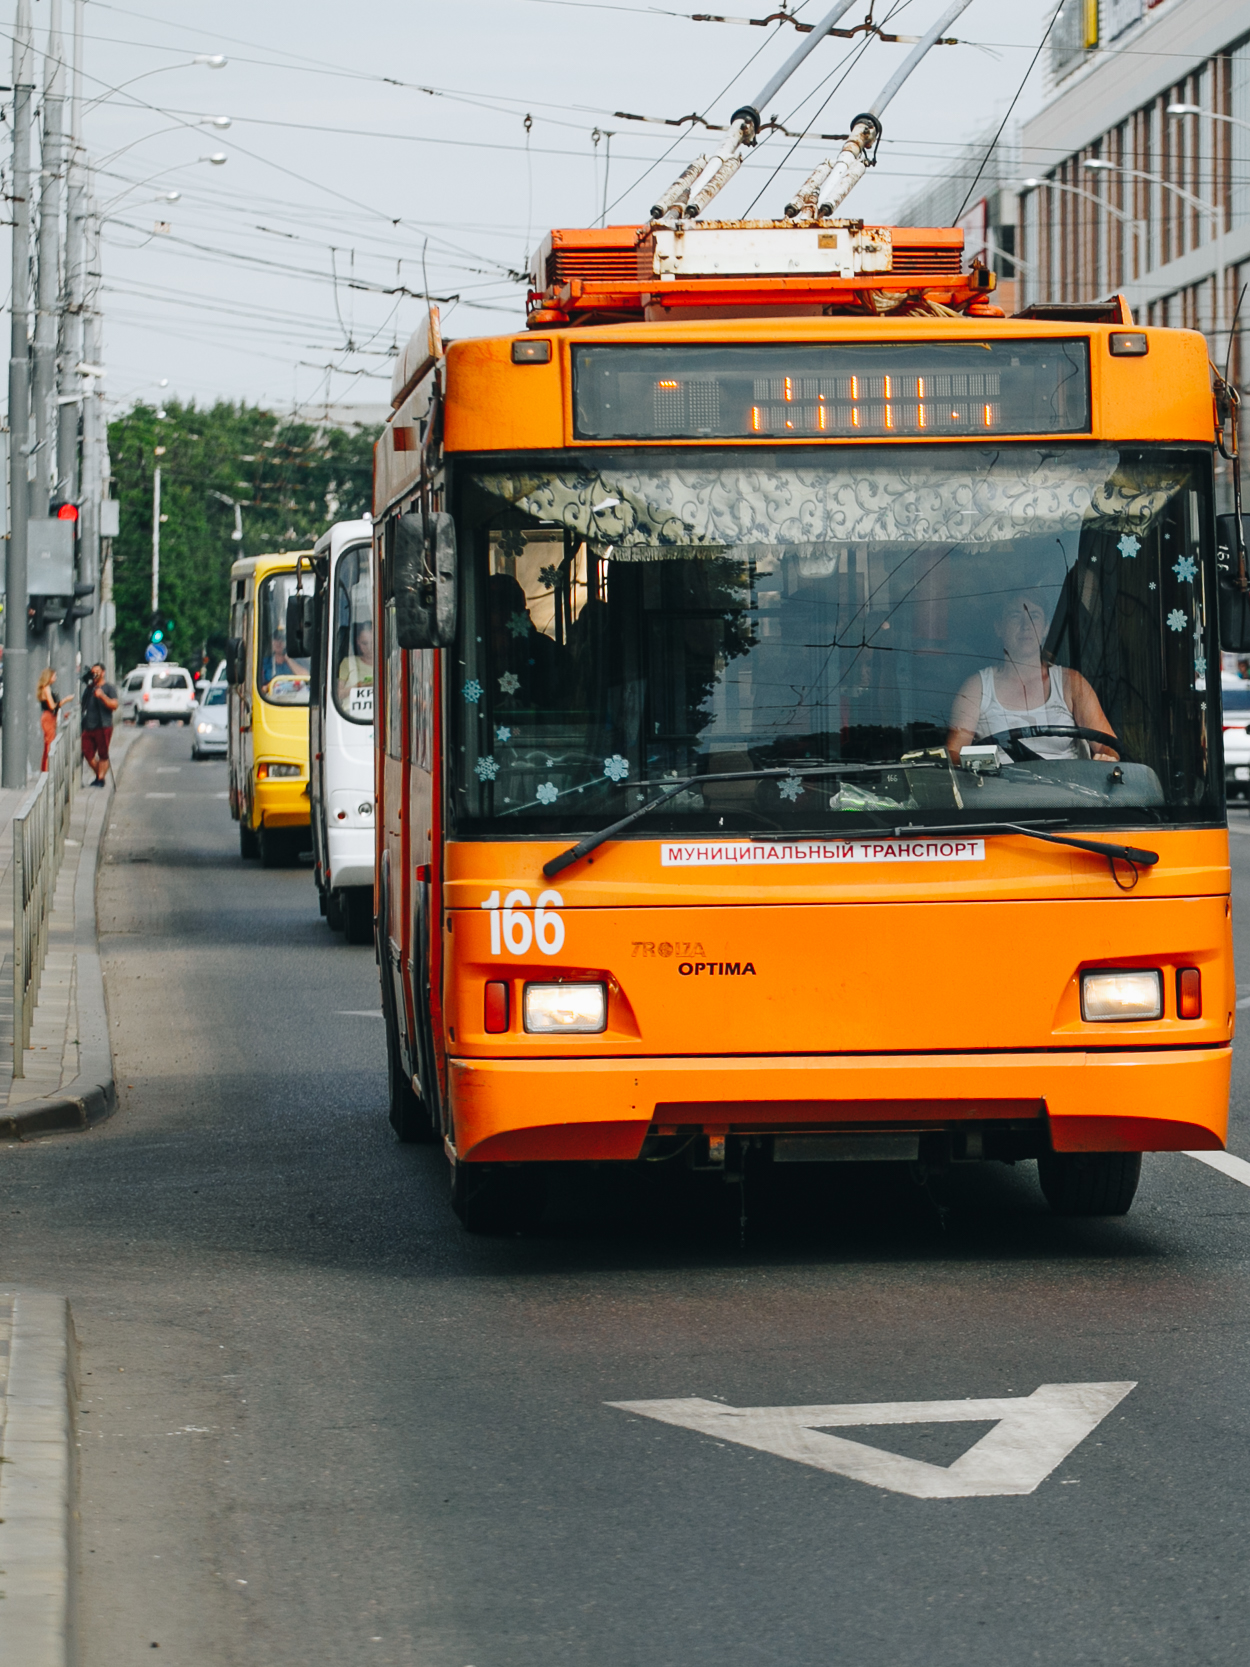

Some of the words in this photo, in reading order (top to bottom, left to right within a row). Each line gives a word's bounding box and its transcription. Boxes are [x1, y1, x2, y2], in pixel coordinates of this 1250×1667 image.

[668, 841, 854, 862] МУНИЦИПАЛЬНЫЙ
[860, 842, 978, 858] ТРАНСПОРТ
[481, 889, 565, 955] 166
[678, 962, 757, 976] OPTIMA
